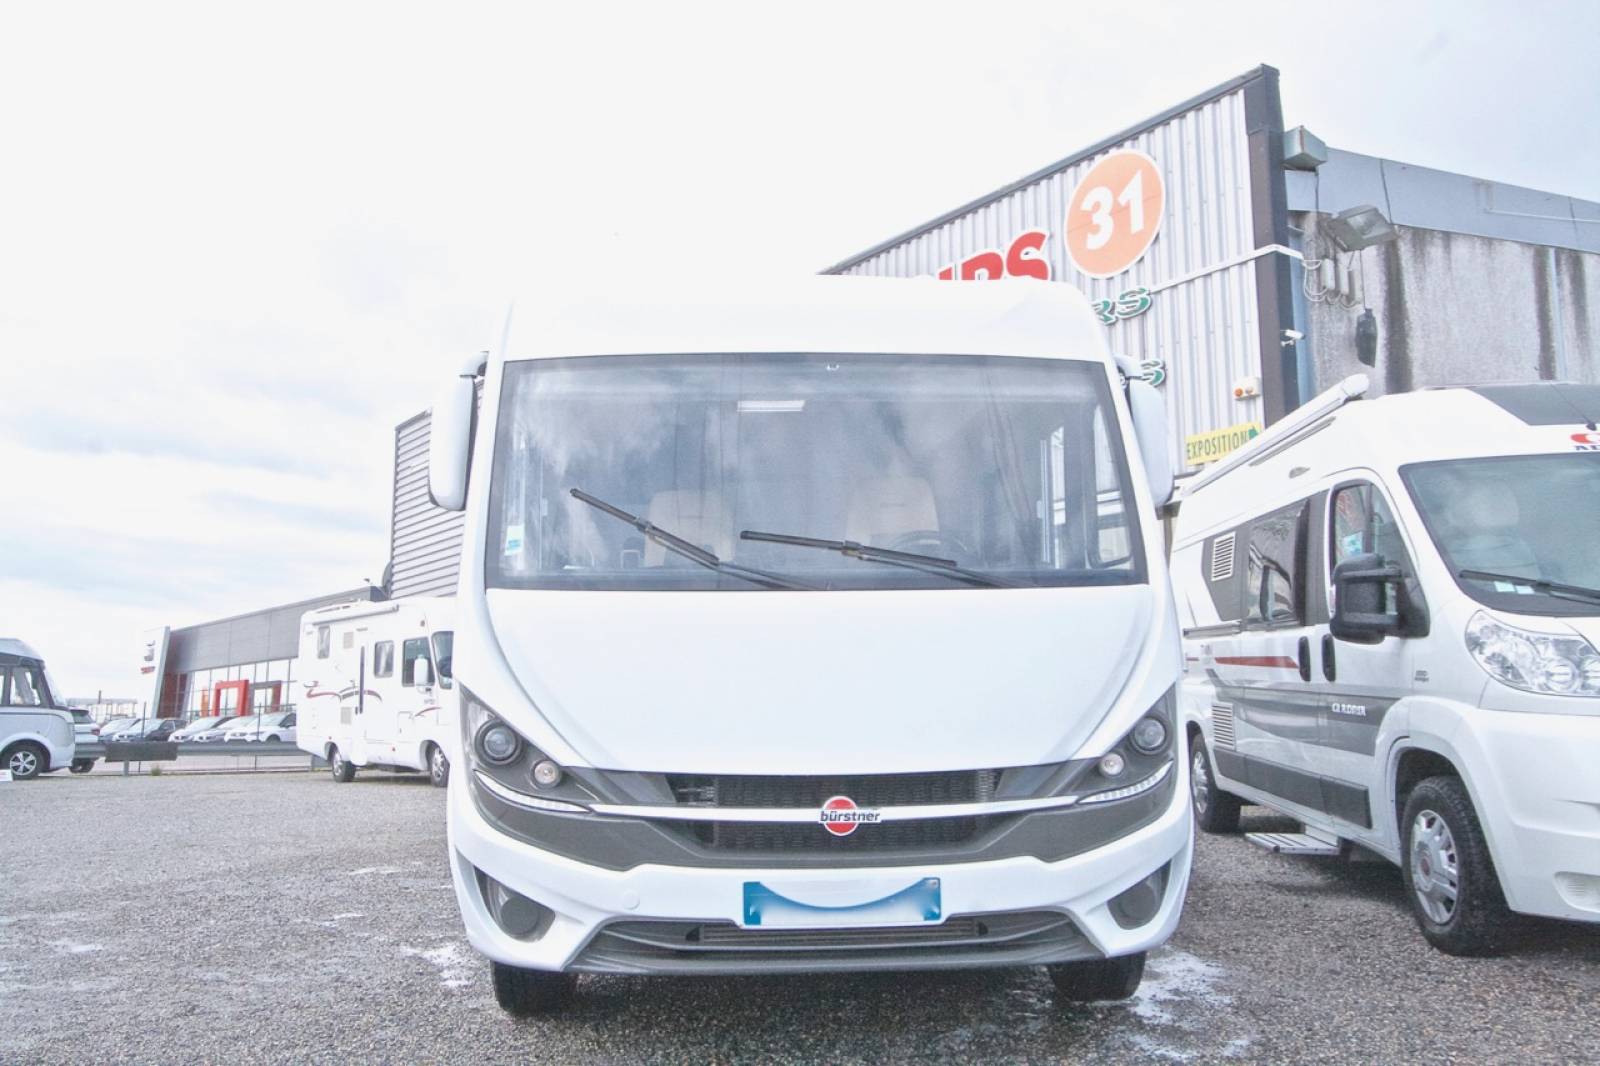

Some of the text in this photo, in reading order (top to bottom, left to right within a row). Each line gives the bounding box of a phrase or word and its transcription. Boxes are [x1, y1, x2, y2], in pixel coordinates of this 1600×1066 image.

[1080, 168, 1145, 250] 31
[1187, 430, 1249, 460] EXPOSITION
[820, 810, 880, 821] bürstner
